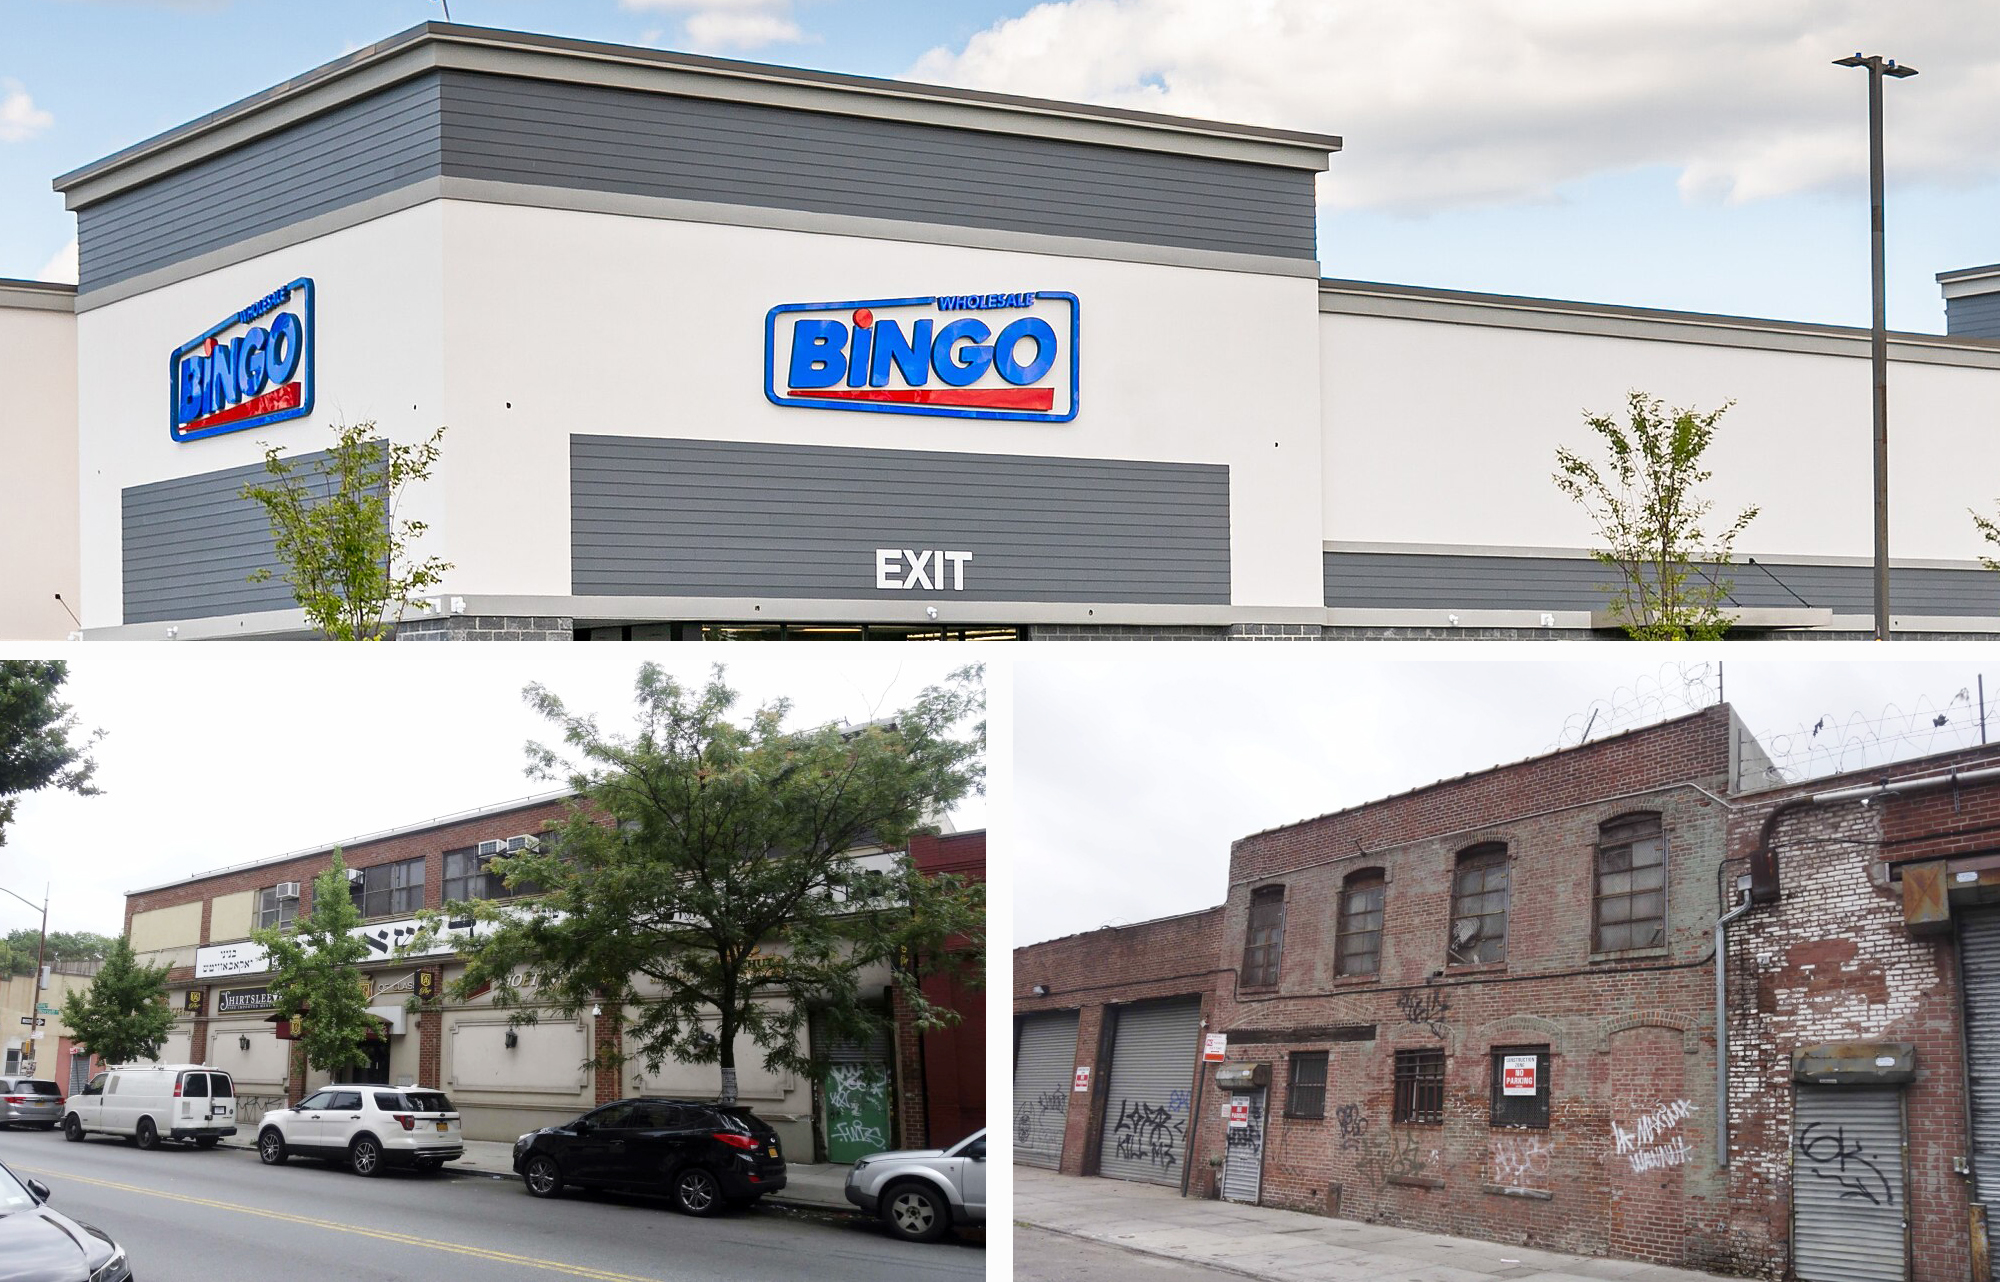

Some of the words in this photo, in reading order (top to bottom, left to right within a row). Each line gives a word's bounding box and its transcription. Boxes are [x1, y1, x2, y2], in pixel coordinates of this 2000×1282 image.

[937, 292, 1035, 311] WHOLESALE
[876, 548, 973, 591] EXIT
[1515, 1069, 1524, 1077] NO
[1506, 1077, 1533, 1085] PARKING
